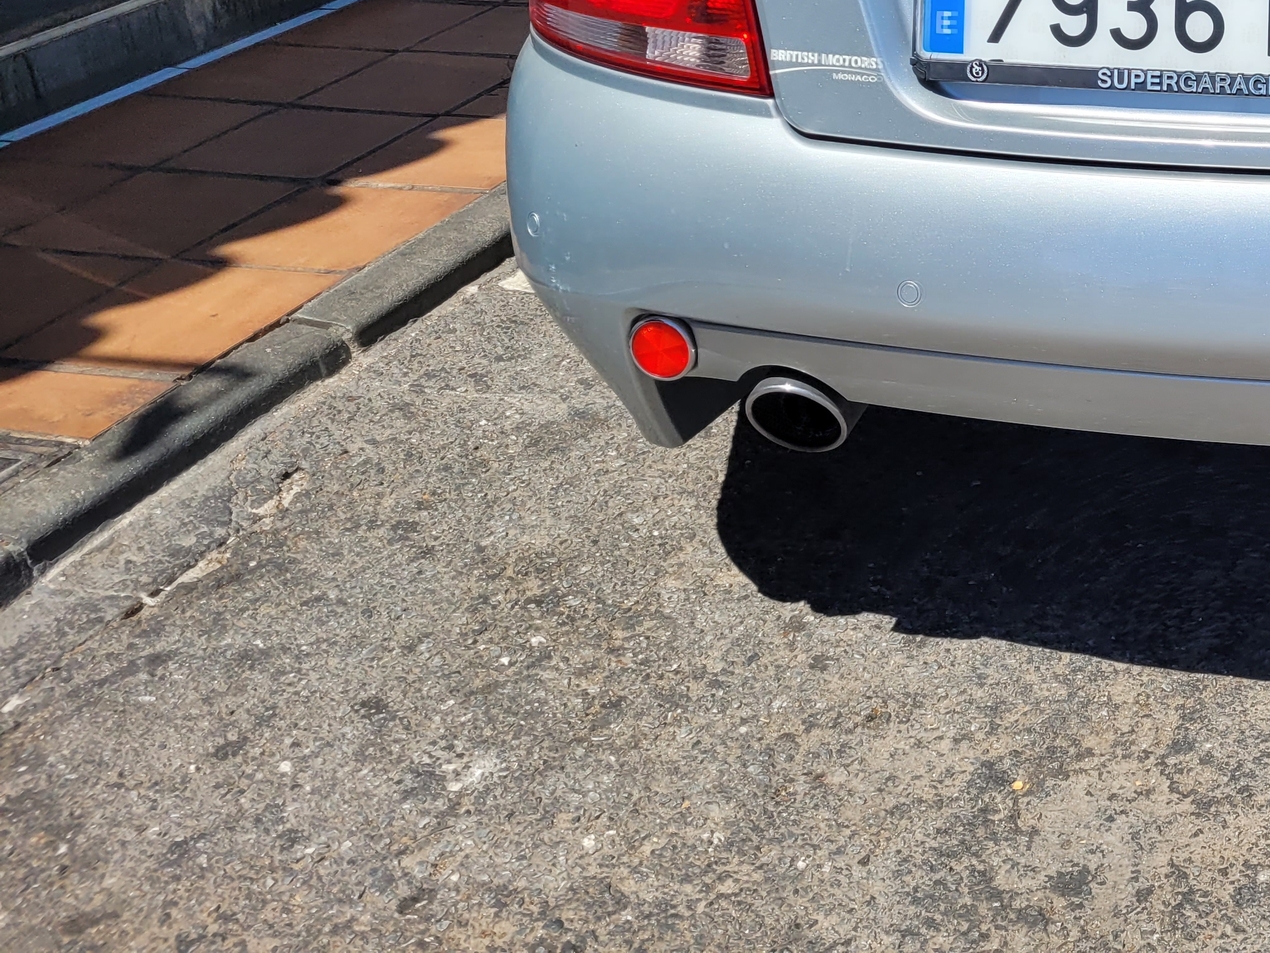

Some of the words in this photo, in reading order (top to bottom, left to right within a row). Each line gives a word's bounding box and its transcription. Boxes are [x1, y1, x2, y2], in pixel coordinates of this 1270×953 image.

[936, 11, 958, 34] E
[770, 49, 818, 64] BRITISH
[821, 54, 878, 69] MOTORS
[832, 73, 878, 83] MONACO
